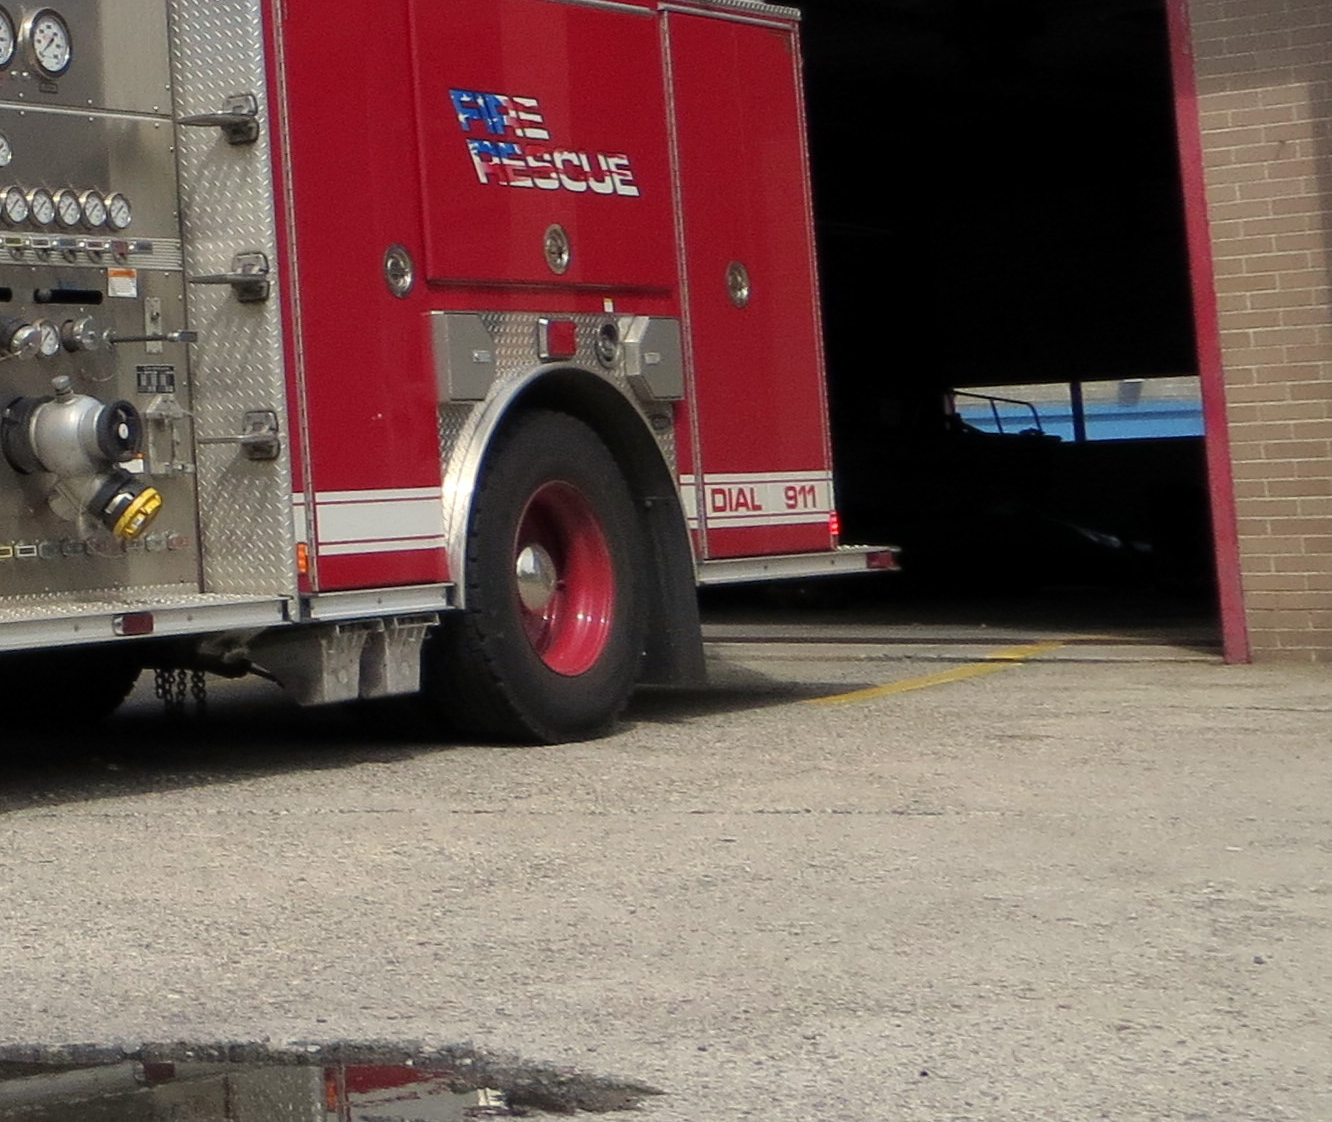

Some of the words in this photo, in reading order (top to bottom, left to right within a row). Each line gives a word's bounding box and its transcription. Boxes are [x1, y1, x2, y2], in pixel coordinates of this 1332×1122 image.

[448, 88, 550, 140] FIRE
[466, 138, 640, 197] RESCUE
[711, 487, 763, 513] DIAL
[784, 485, 817, 510] 911
